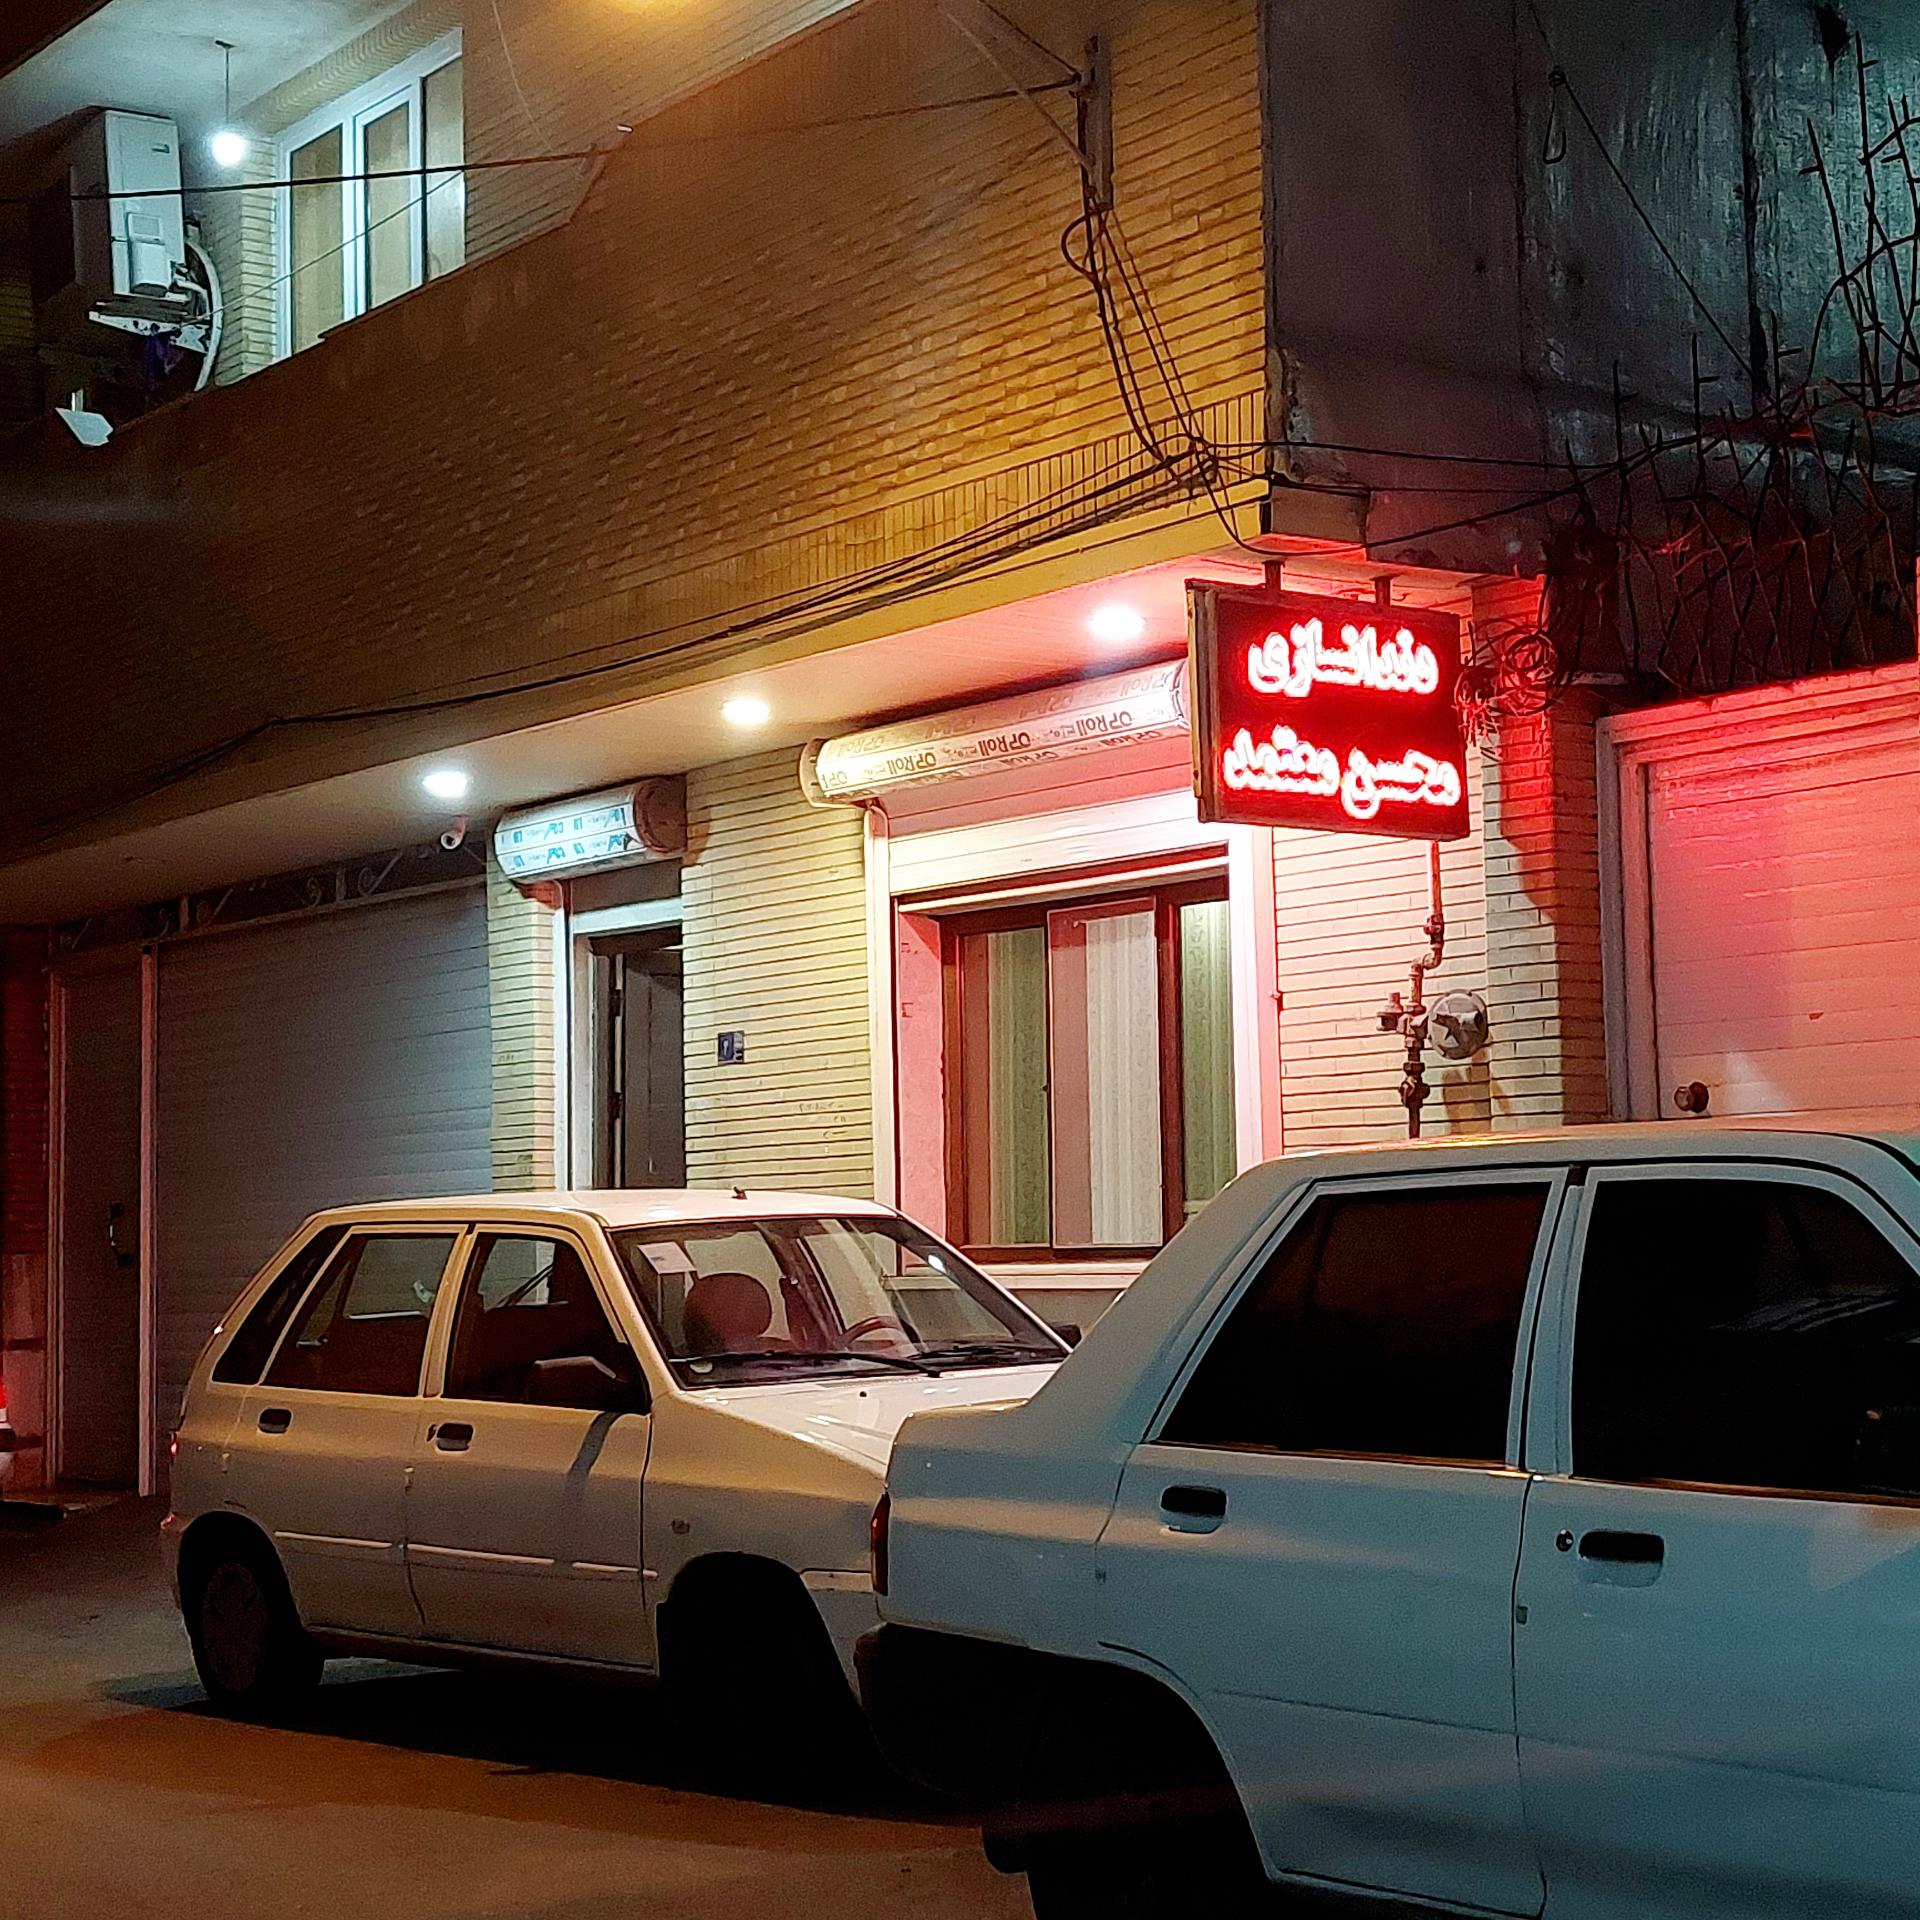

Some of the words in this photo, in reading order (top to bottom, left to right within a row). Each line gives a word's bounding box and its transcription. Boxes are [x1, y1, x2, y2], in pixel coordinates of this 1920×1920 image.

[1248, 617, 1439, 697] دندانسازی
[977, 731, 1032, 757] OPRoll
[1341, 746, 1461, 819] محسن
